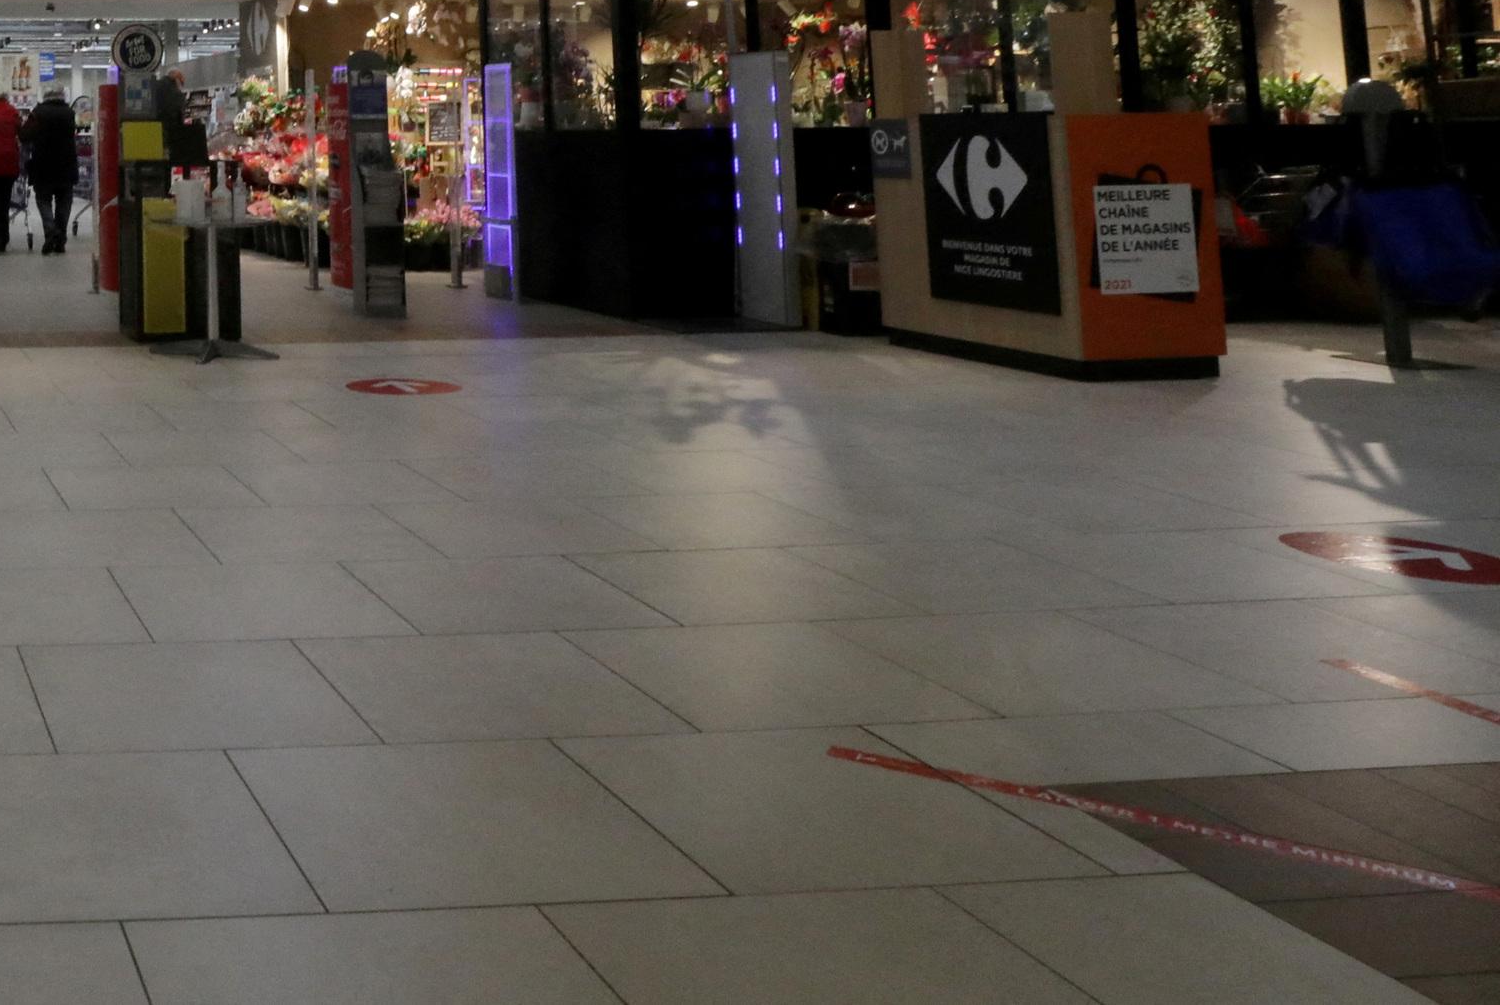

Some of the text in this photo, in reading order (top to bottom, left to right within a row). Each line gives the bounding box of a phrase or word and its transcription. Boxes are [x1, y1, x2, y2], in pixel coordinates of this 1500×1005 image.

[1097, 189, 1171, 202] MEILLEURE
[1098, 204, 1149, 219] CHAÎNE
[1100, 222, 1191, 235] DE MAGASINS
[1101, 237, 1180, 252] DE L'ANNÉE
[1104, 280, 1132, 290] 2021
[1290, 845, 1457, 891] MINIMUM
